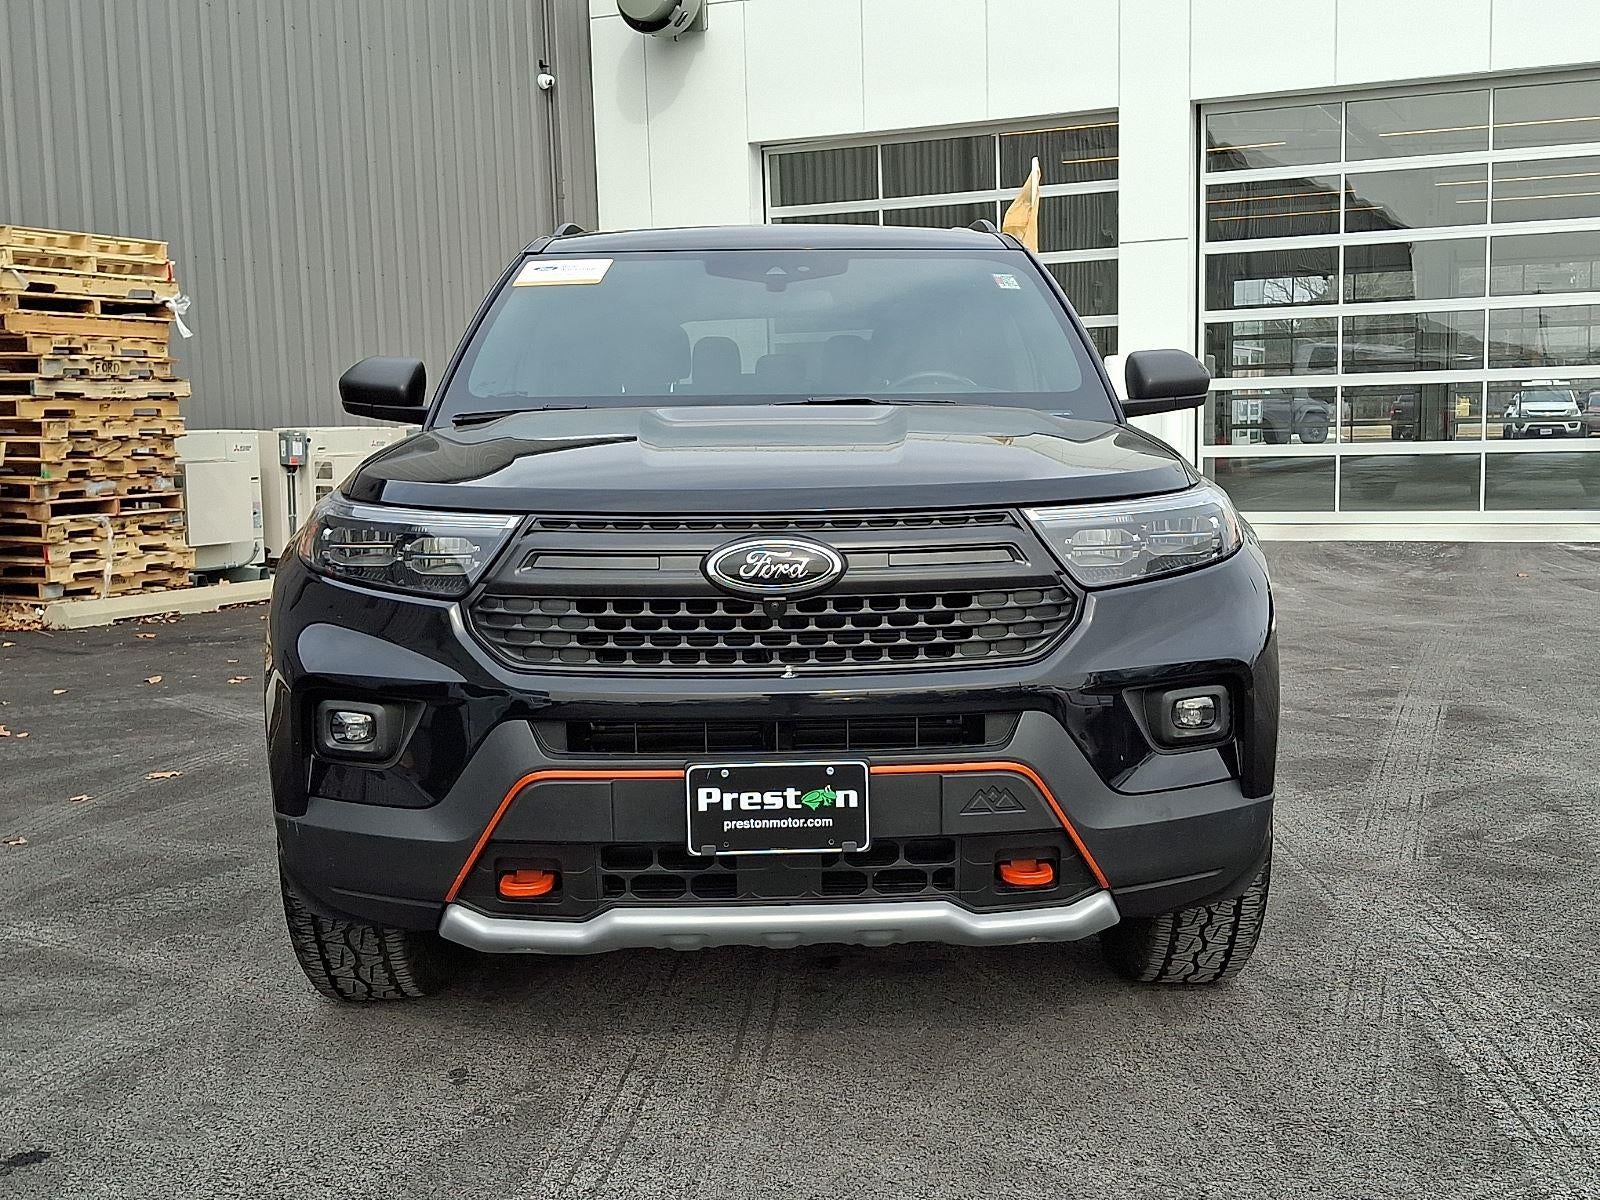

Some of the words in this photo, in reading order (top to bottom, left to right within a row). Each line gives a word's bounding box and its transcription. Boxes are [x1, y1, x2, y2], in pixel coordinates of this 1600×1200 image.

[95, 362, 120, 373] FORD
[739, 550, 810, 580] Ford
[723, 818, 833, 832] prestonmotor.com
